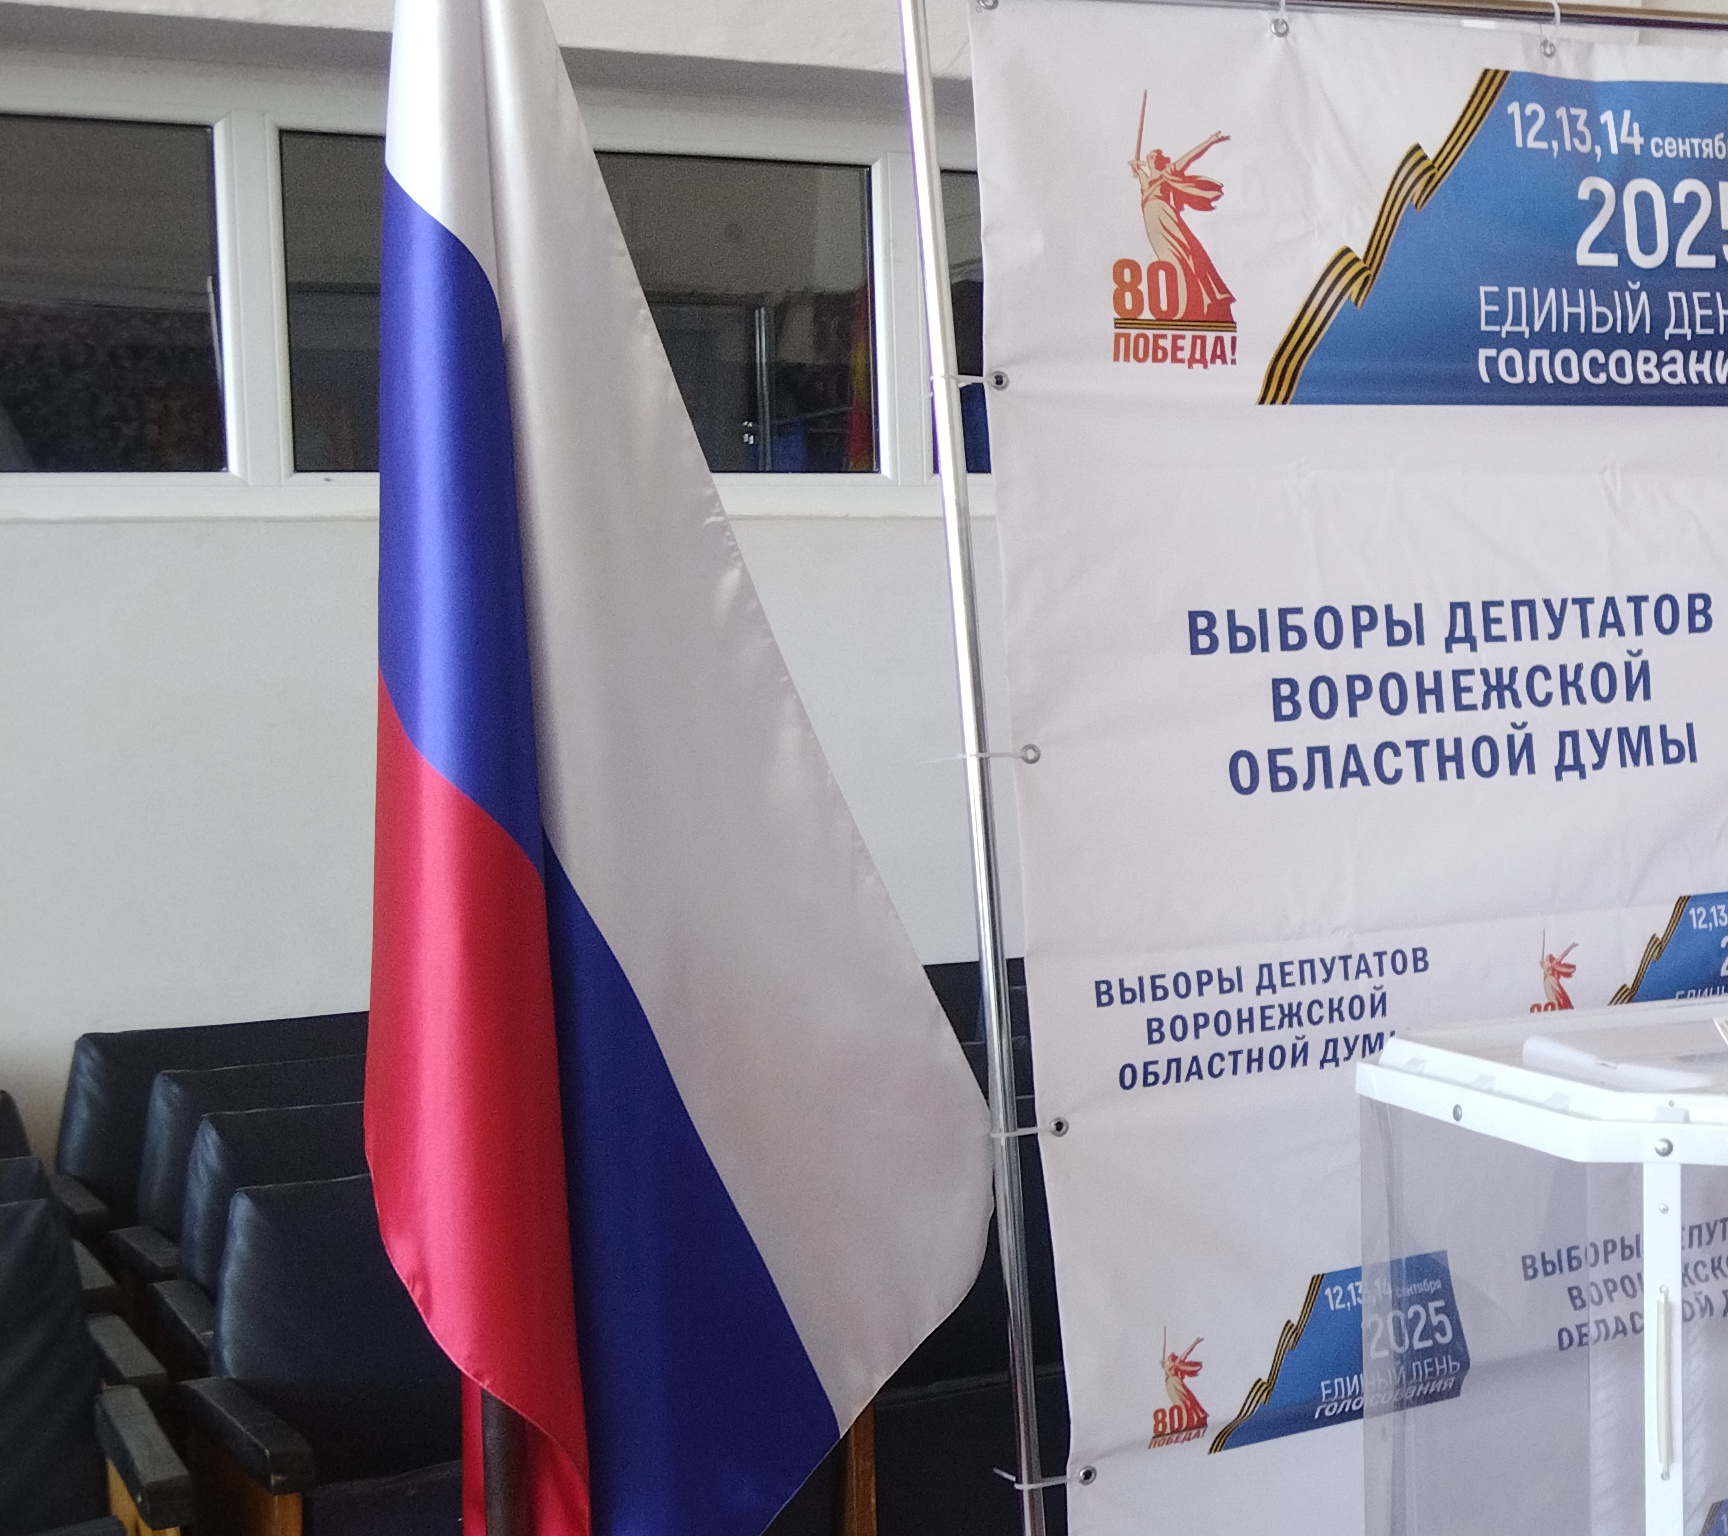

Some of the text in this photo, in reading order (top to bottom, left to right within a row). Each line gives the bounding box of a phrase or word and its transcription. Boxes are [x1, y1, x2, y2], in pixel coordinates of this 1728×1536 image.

[1507, 101, 1644, 162] 12,13,14
[1112, 258, 1179, 320] 80
[1479, 281, 1650, 339] ЕДИНЫЙ
[1113, 332, 1238, 370] ПОБЕДА!
[1187, 592, 1714, 656] ВЫБОРЫ ДЕПУТАТОВ
[1271, 648, 1653, 723] ВОРОНЕЖСКОЙ
[1228, 721, 1699, 796] ОБЛАСТНОЙ ДУМЫ
[1094, 946, 1430, 1008] ВЫБОРЫ ДЕПУТАТОВ
[1146, 984, 1388, 1046] ВОРОНЕЖСКОЙ
[1118, 1030, 1396, 1091] ОБЛАСТНОЙ ДУМ
[1521, 1233, 1642, 1281] ВЫБОРЫ
[1362, 1299, 1453, 1359] 2025
[1410, 1355, 1461, 1383] ДЕНЬ
[1153, 1405, 1184, 1435] 80
